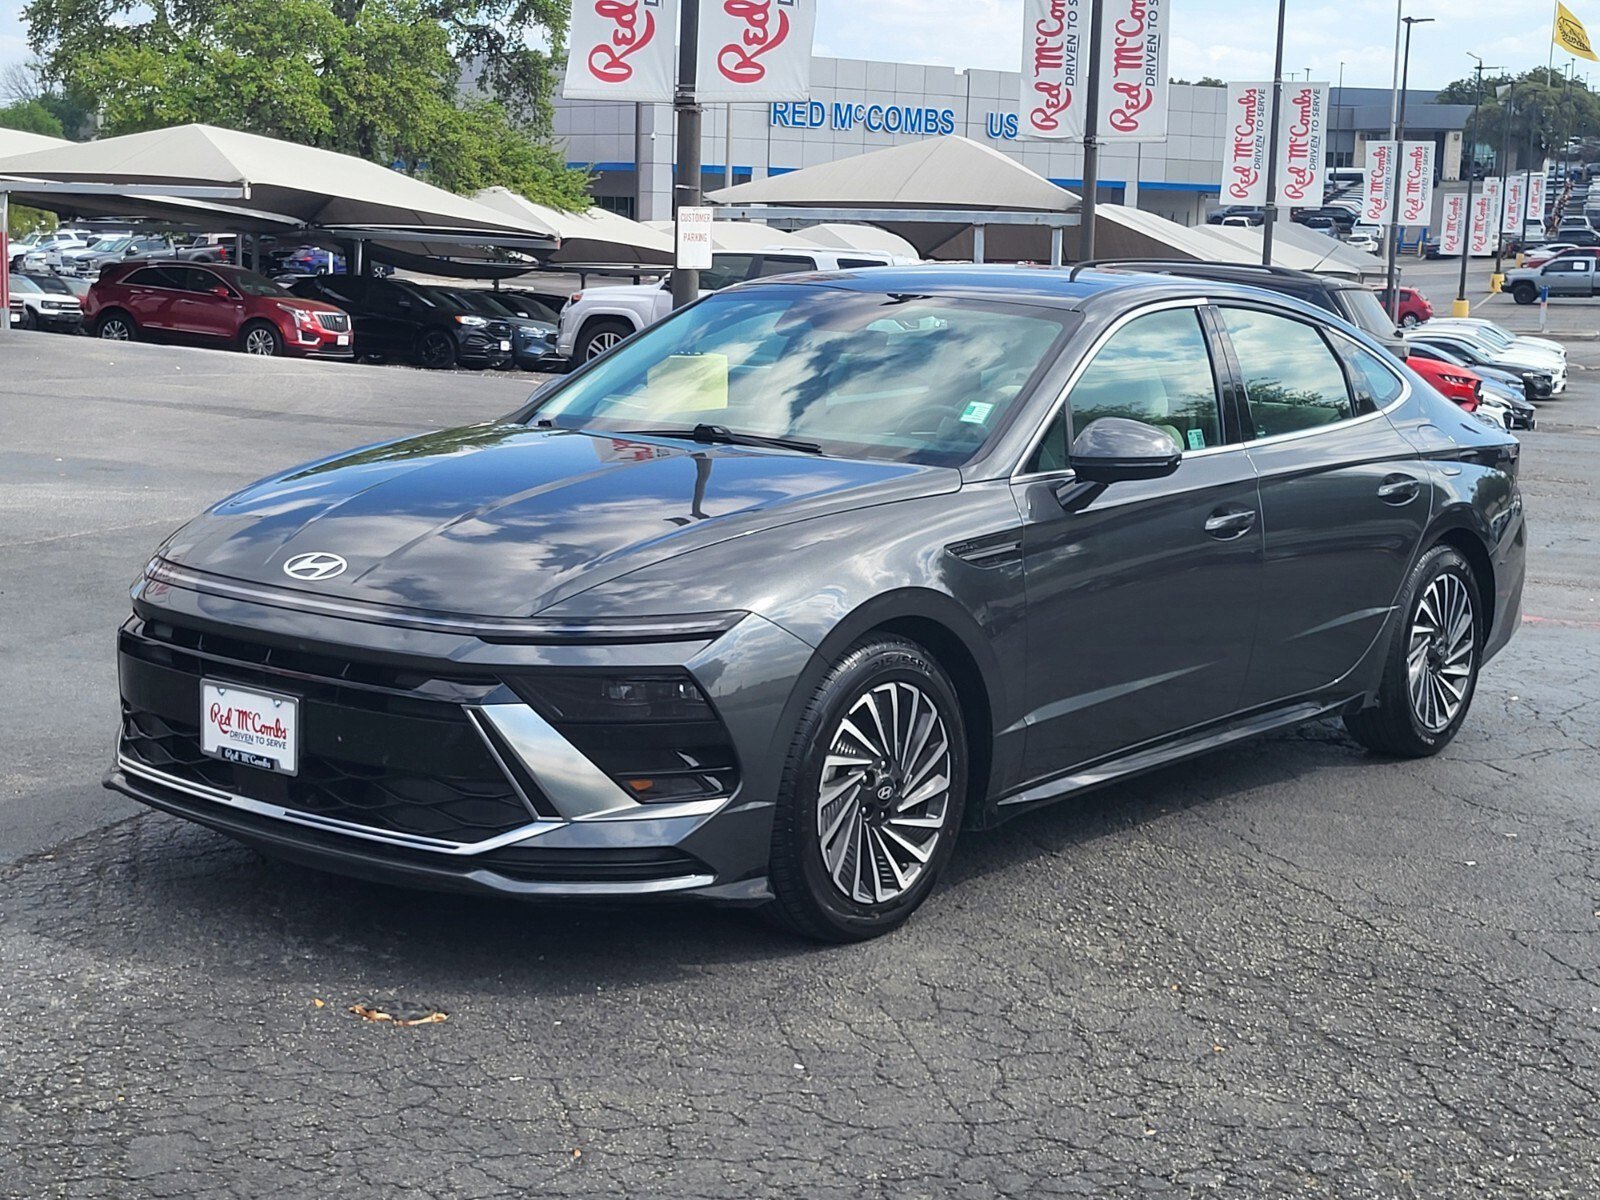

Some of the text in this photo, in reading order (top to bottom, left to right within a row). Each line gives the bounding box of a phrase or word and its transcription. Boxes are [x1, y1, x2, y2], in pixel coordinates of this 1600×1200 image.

[588, 0, 655, 83] Red
[717, 0, 790, 84] Red
[1067, 10, 1078, 30] TO
[1147, 10, 1158, 30] TO
[1065, 34, 1077, 87] DRIVEN
[1145, 34, 1157, 87] DRIVEN
[772, 101, 826, 128] RED
[1030, 82, 1072, 131] Red
[1109, 82, 1153, 132] Red
[1254, 88, 1265, 170] DRIVEN TO SERVE
[1309, 88, 1320, 171] DRIVEN TO SERVE
[1229, 88, 1258, 199] Red McCombs
[1284, 88, 1314, 199] Red McCombs
[1367, 146, 1387, 219] Red McCombs
[1404, 146, 1424, 220] Red McCombs
[680, 213, 711, 223] CUSTOMER
[683, 232, 708, 242] PARKING
[210, 702, 287, 740] Red McCombs
[229, 730, 287, 750] DRIVEN TO SERVE
[224, 748, 239, 761] Red
